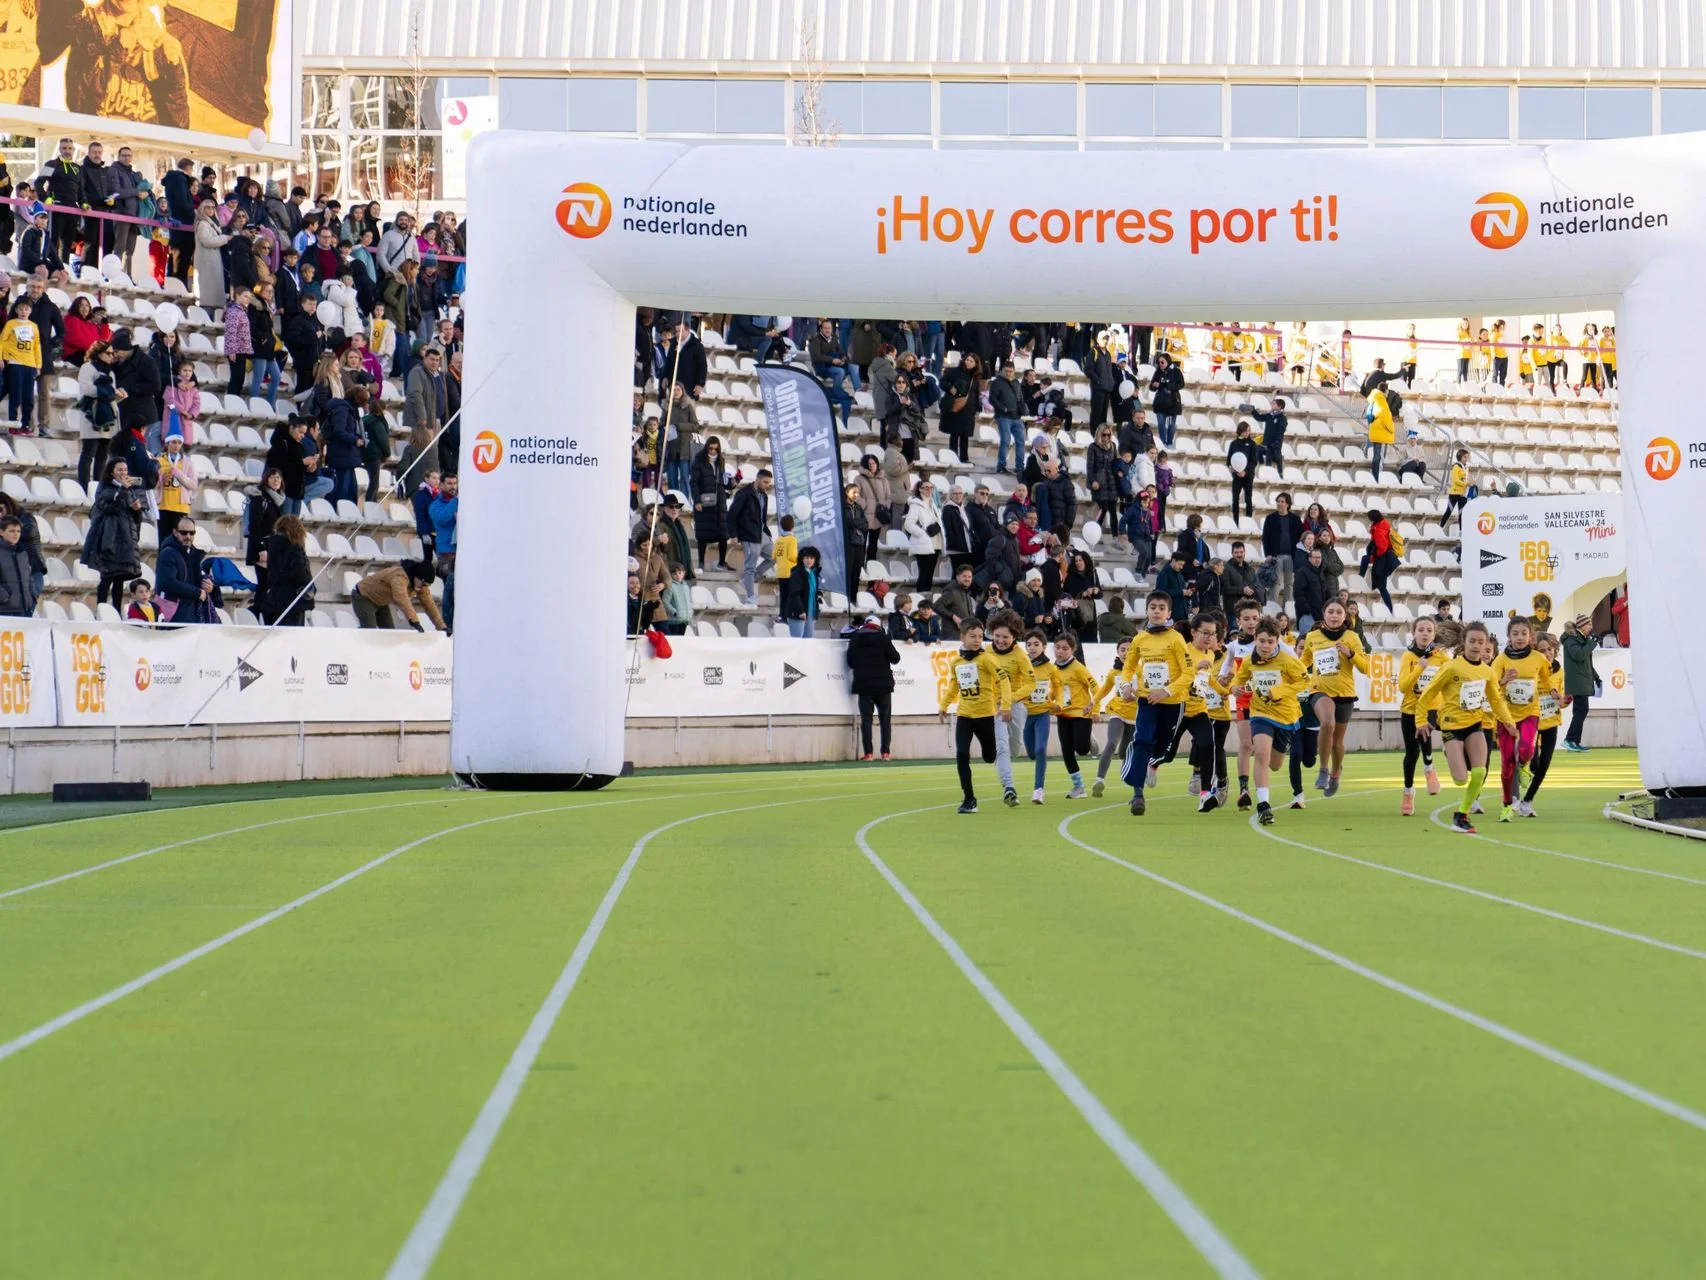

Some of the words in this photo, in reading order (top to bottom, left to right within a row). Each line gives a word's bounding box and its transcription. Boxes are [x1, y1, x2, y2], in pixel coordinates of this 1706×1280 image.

[624, 196, 715, 215] nationale
[1540, 193, 1634, 214] nationale
[623, 216, 747, 237] nederlanden
[877, 195, 994, 254] ¡Hoy
[1009, 208, 1174, 243] corres
[1191, 208, 1277, 254] por
[1290, 195, 1338, 242] ti!
[1541, 212, 1668, 235] nederlanden
[510, 436, 577, 450] nationale
[510, 451, 598, 466] nederlanden
[1499, 513, 1529, 522] nationale
[1544, 512, 1561, 520] SAN
[1563, 510, 1605, 519] SILVESTRE
[1499, 522, 1539, 530] nederlanden
[1544, 519, 1590, 528] VALLECANA
[1482, 610, 1504, 619] MARCA
